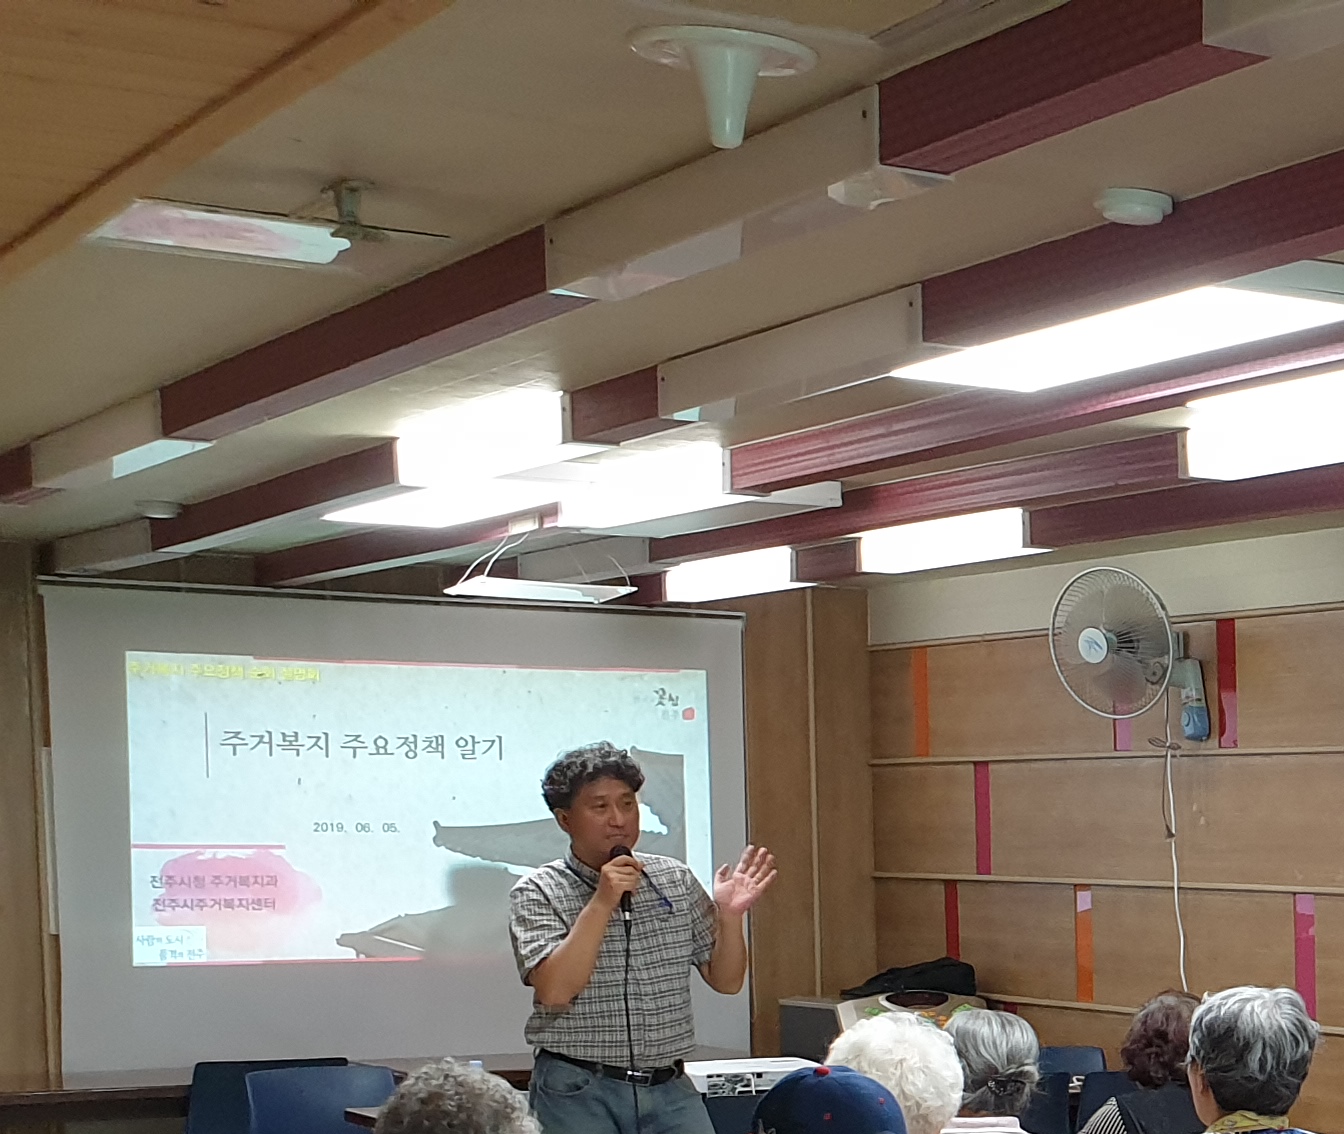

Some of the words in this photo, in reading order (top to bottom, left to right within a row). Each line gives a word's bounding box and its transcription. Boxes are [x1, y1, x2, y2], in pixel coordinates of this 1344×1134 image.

[219, 730, 330, 759] 주거복지
[340, 733, 446, 760] 주요정책
[454, 734, 504, 761] 알기
[313, 821, 348, 834] 2019.
[355, 821, 374, 834] 06.
[382, 822, 401, 834] 05.
[149, 874, 206, 890] 전주시청
[210, 874, 279, 890] 주거복지과
[152, 897, 277, 913] 전주시주거복지센터
[165, 934, 184, 946] 도시
